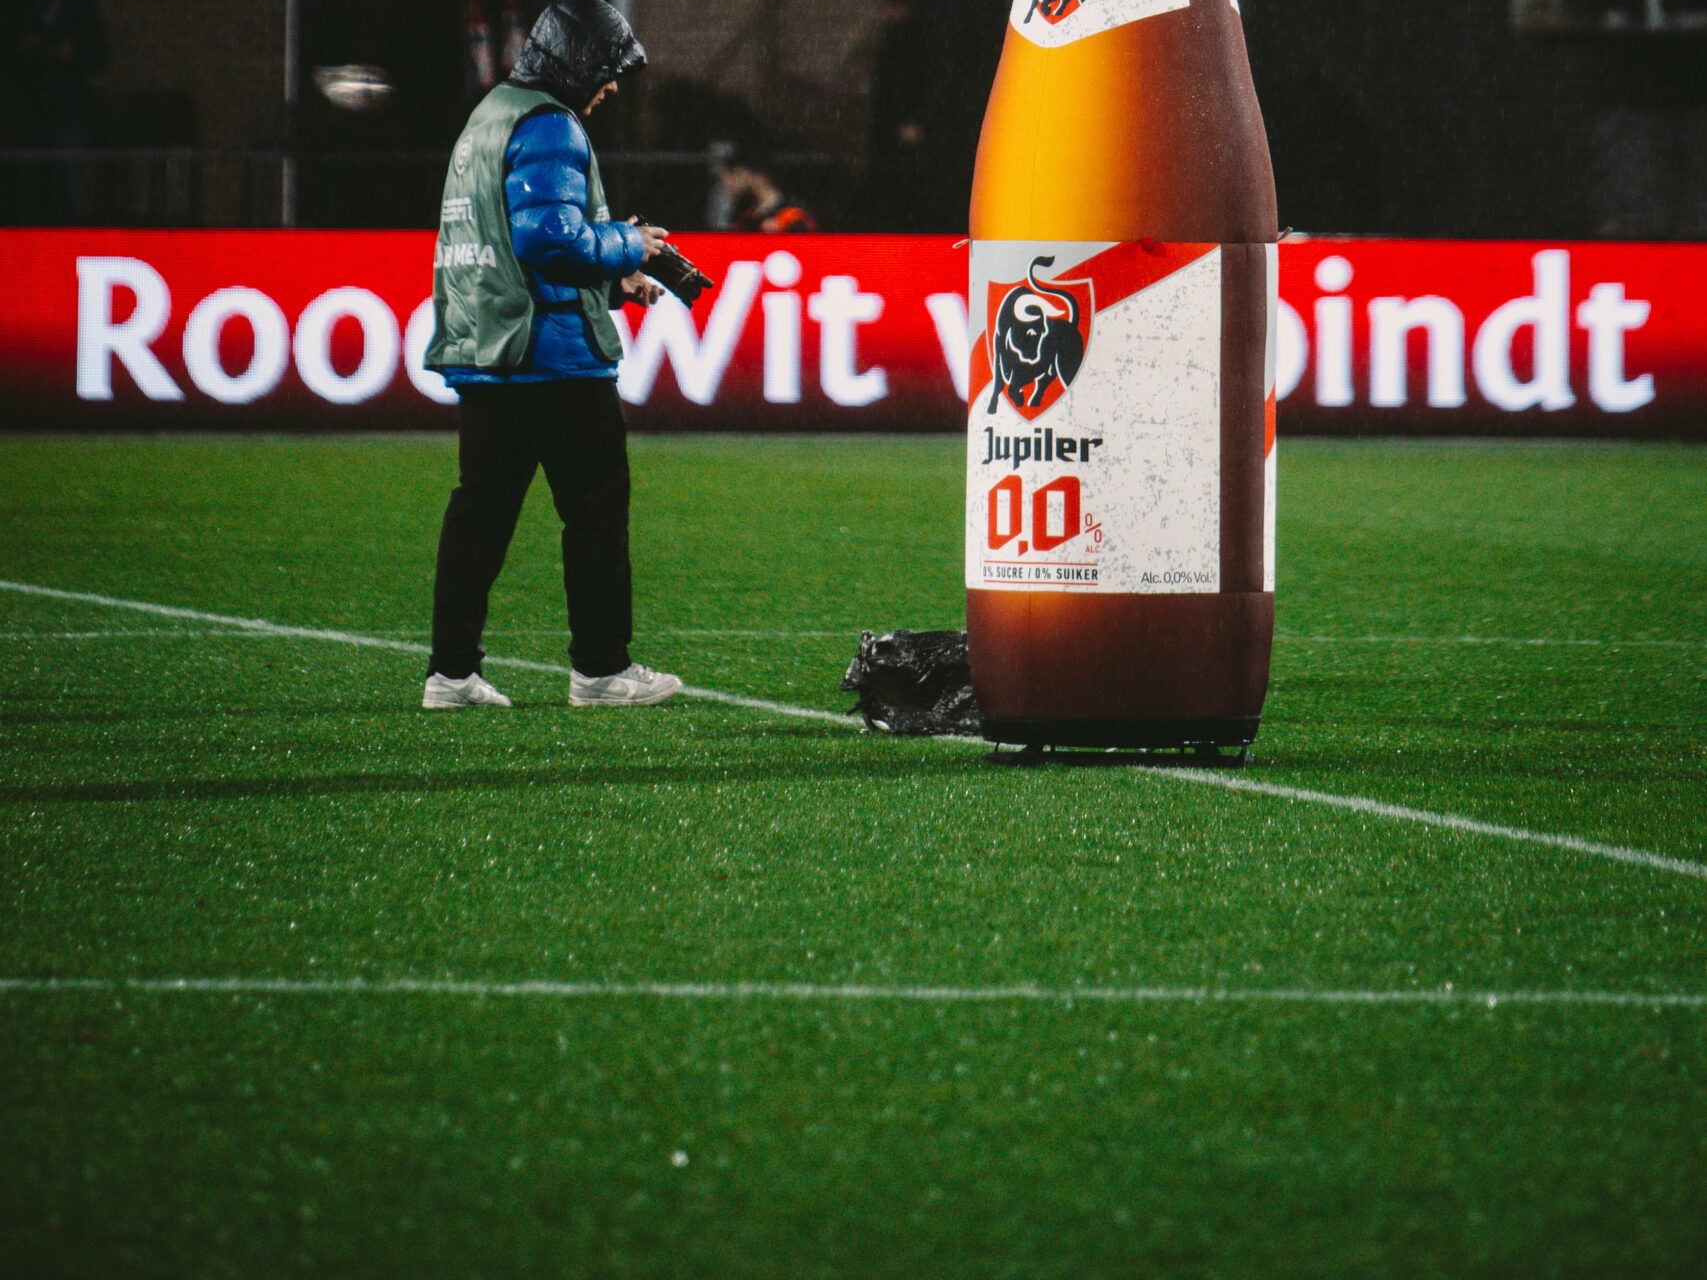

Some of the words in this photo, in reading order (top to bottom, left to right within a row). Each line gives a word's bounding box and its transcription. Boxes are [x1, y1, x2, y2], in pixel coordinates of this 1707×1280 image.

[981, 426, 1104, 471] Jupiler
[996, 567, 1023, 579] SUCRE
[1035, 568, 1051, 579] 0%
[1056, 568, 1098, 581] SUIKER
[1141, 571, 1163, 584] Alc.
[1163, 571, 1192, 585] 0,0%
